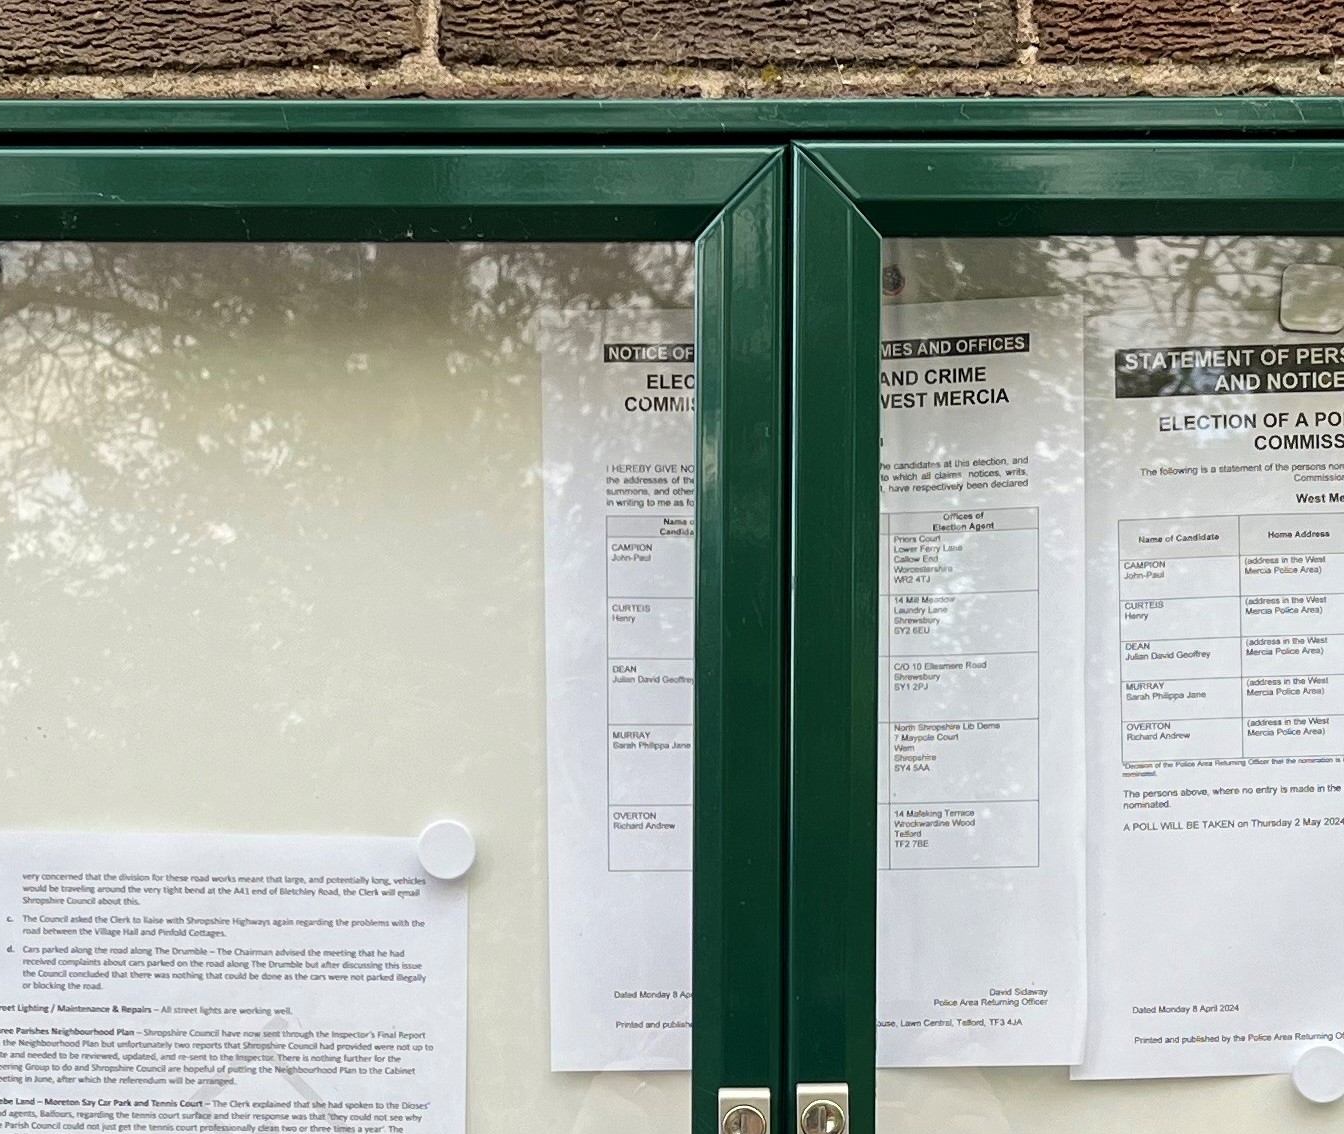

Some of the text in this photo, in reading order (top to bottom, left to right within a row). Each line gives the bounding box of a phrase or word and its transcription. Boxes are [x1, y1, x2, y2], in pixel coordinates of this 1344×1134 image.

[608, 346, 694, 360] NOTICE OF
[917, 340, 951, 355] AND
[956, 336, 1025, 353] OFFICES
[1125, 349, 1254, 370] STATEMENT
[1261, 349, 1289, 365] OF
[924, 366, 986, 385] CRIME
[1212, 374, 1260, 393] AND
[624, 396, 695, 412] COMMI
[934, 388, 1009, 407] MERCIA
[1159, 413, 1257, 432] ELECTION
[1263, 412, 1289, 428] OF
[1295, 412, 1309, 427] A
[1296, 493, 1326, 503] West
